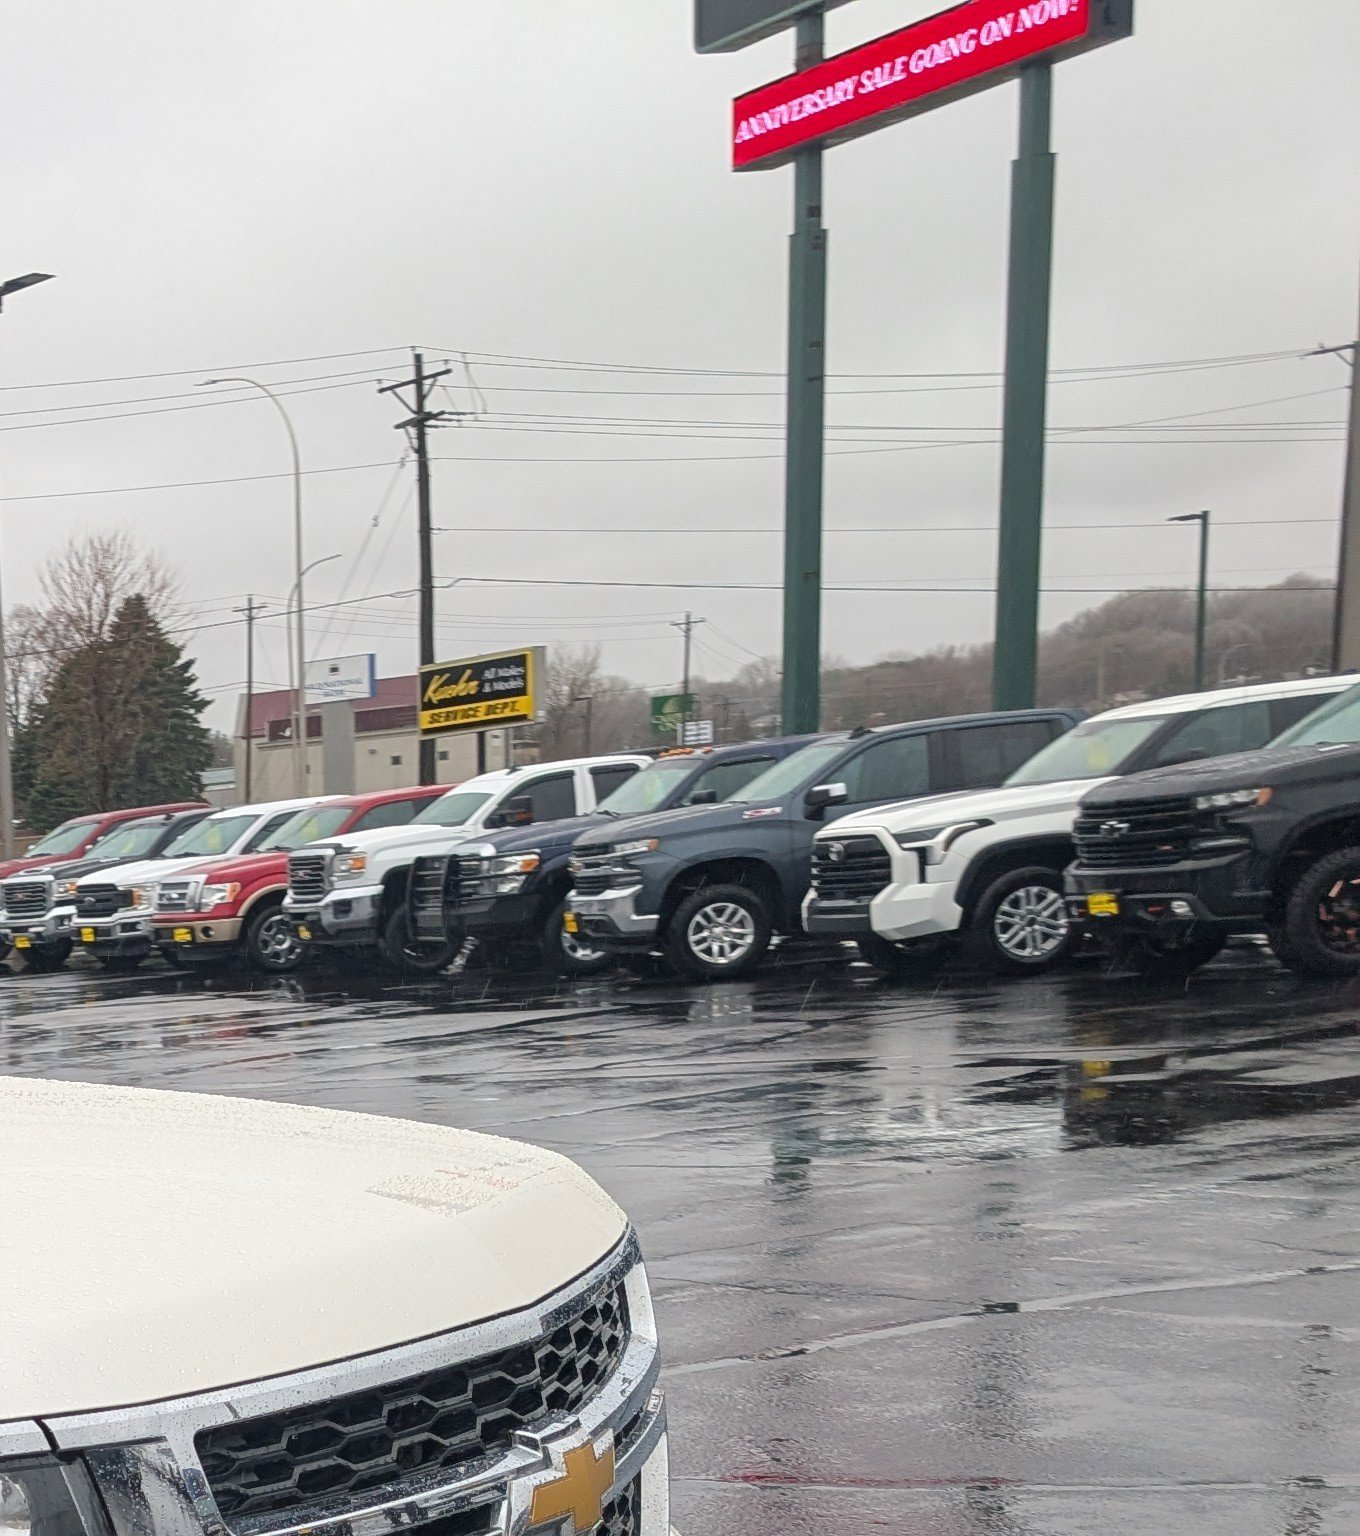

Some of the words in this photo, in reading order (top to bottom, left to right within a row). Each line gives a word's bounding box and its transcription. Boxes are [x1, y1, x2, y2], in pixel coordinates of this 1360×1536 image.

[734, 75, 859, 143] ANNIVERSARY
[858, 55, 909, 94] SALE
[909, 28, 978, 73] GOING
[980, 12, 1016, 46] ON
